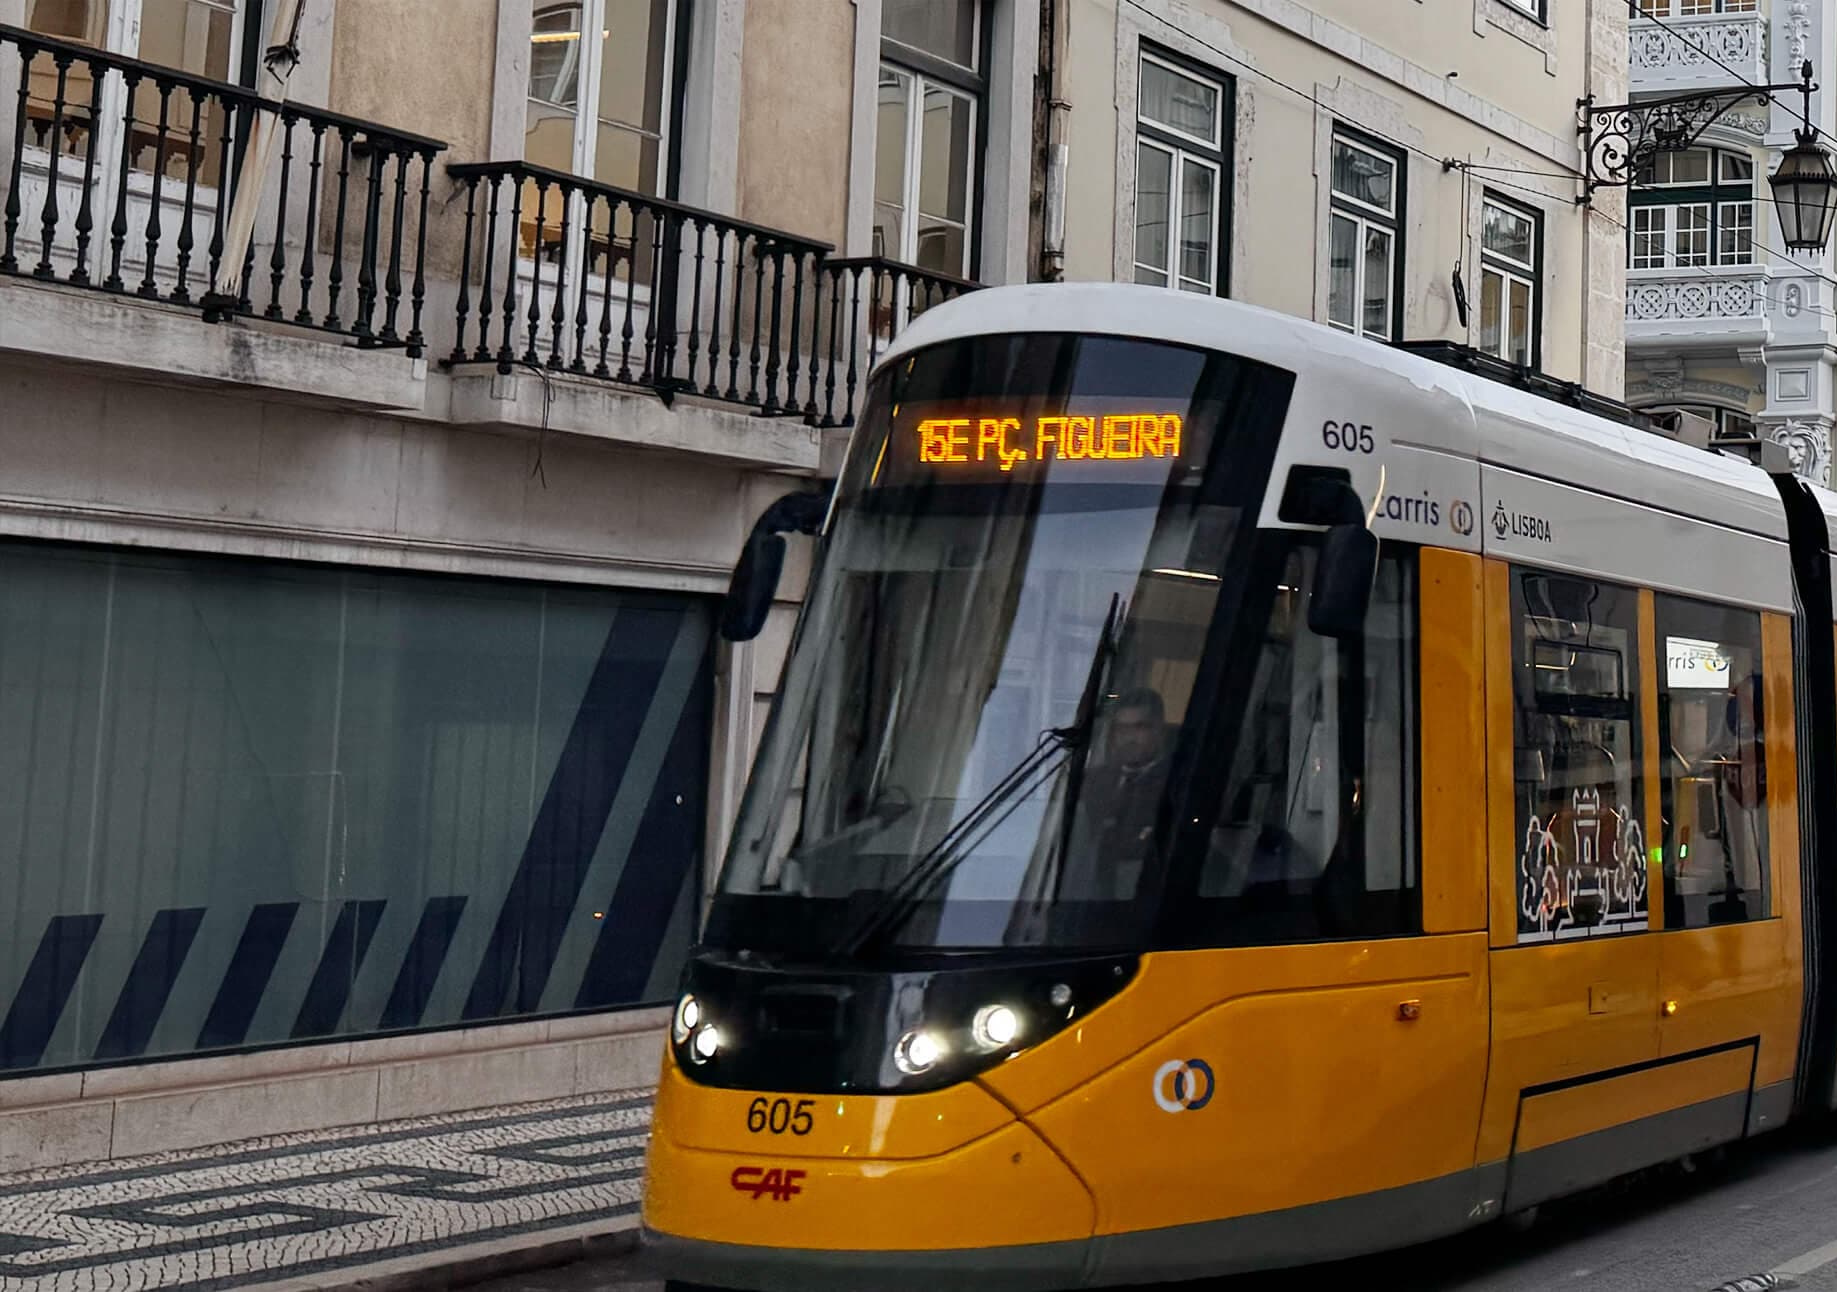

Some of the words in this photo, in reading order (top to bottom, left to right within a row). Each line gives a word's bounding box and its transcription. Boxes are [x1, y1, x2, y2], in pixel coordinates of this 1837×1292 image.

[916, 419, 970, 462] 15E
[976, 417, 1027, 471] PÇ.
[1035, 415, 1182, 460] FIGUEIRA
[1322, 420, 1375, 454] 605
[1511, 512, 1552, 542] LISBOA
[746, 1096, 816, 1136] 605
[731, 1166, 807, 1202] CAF
